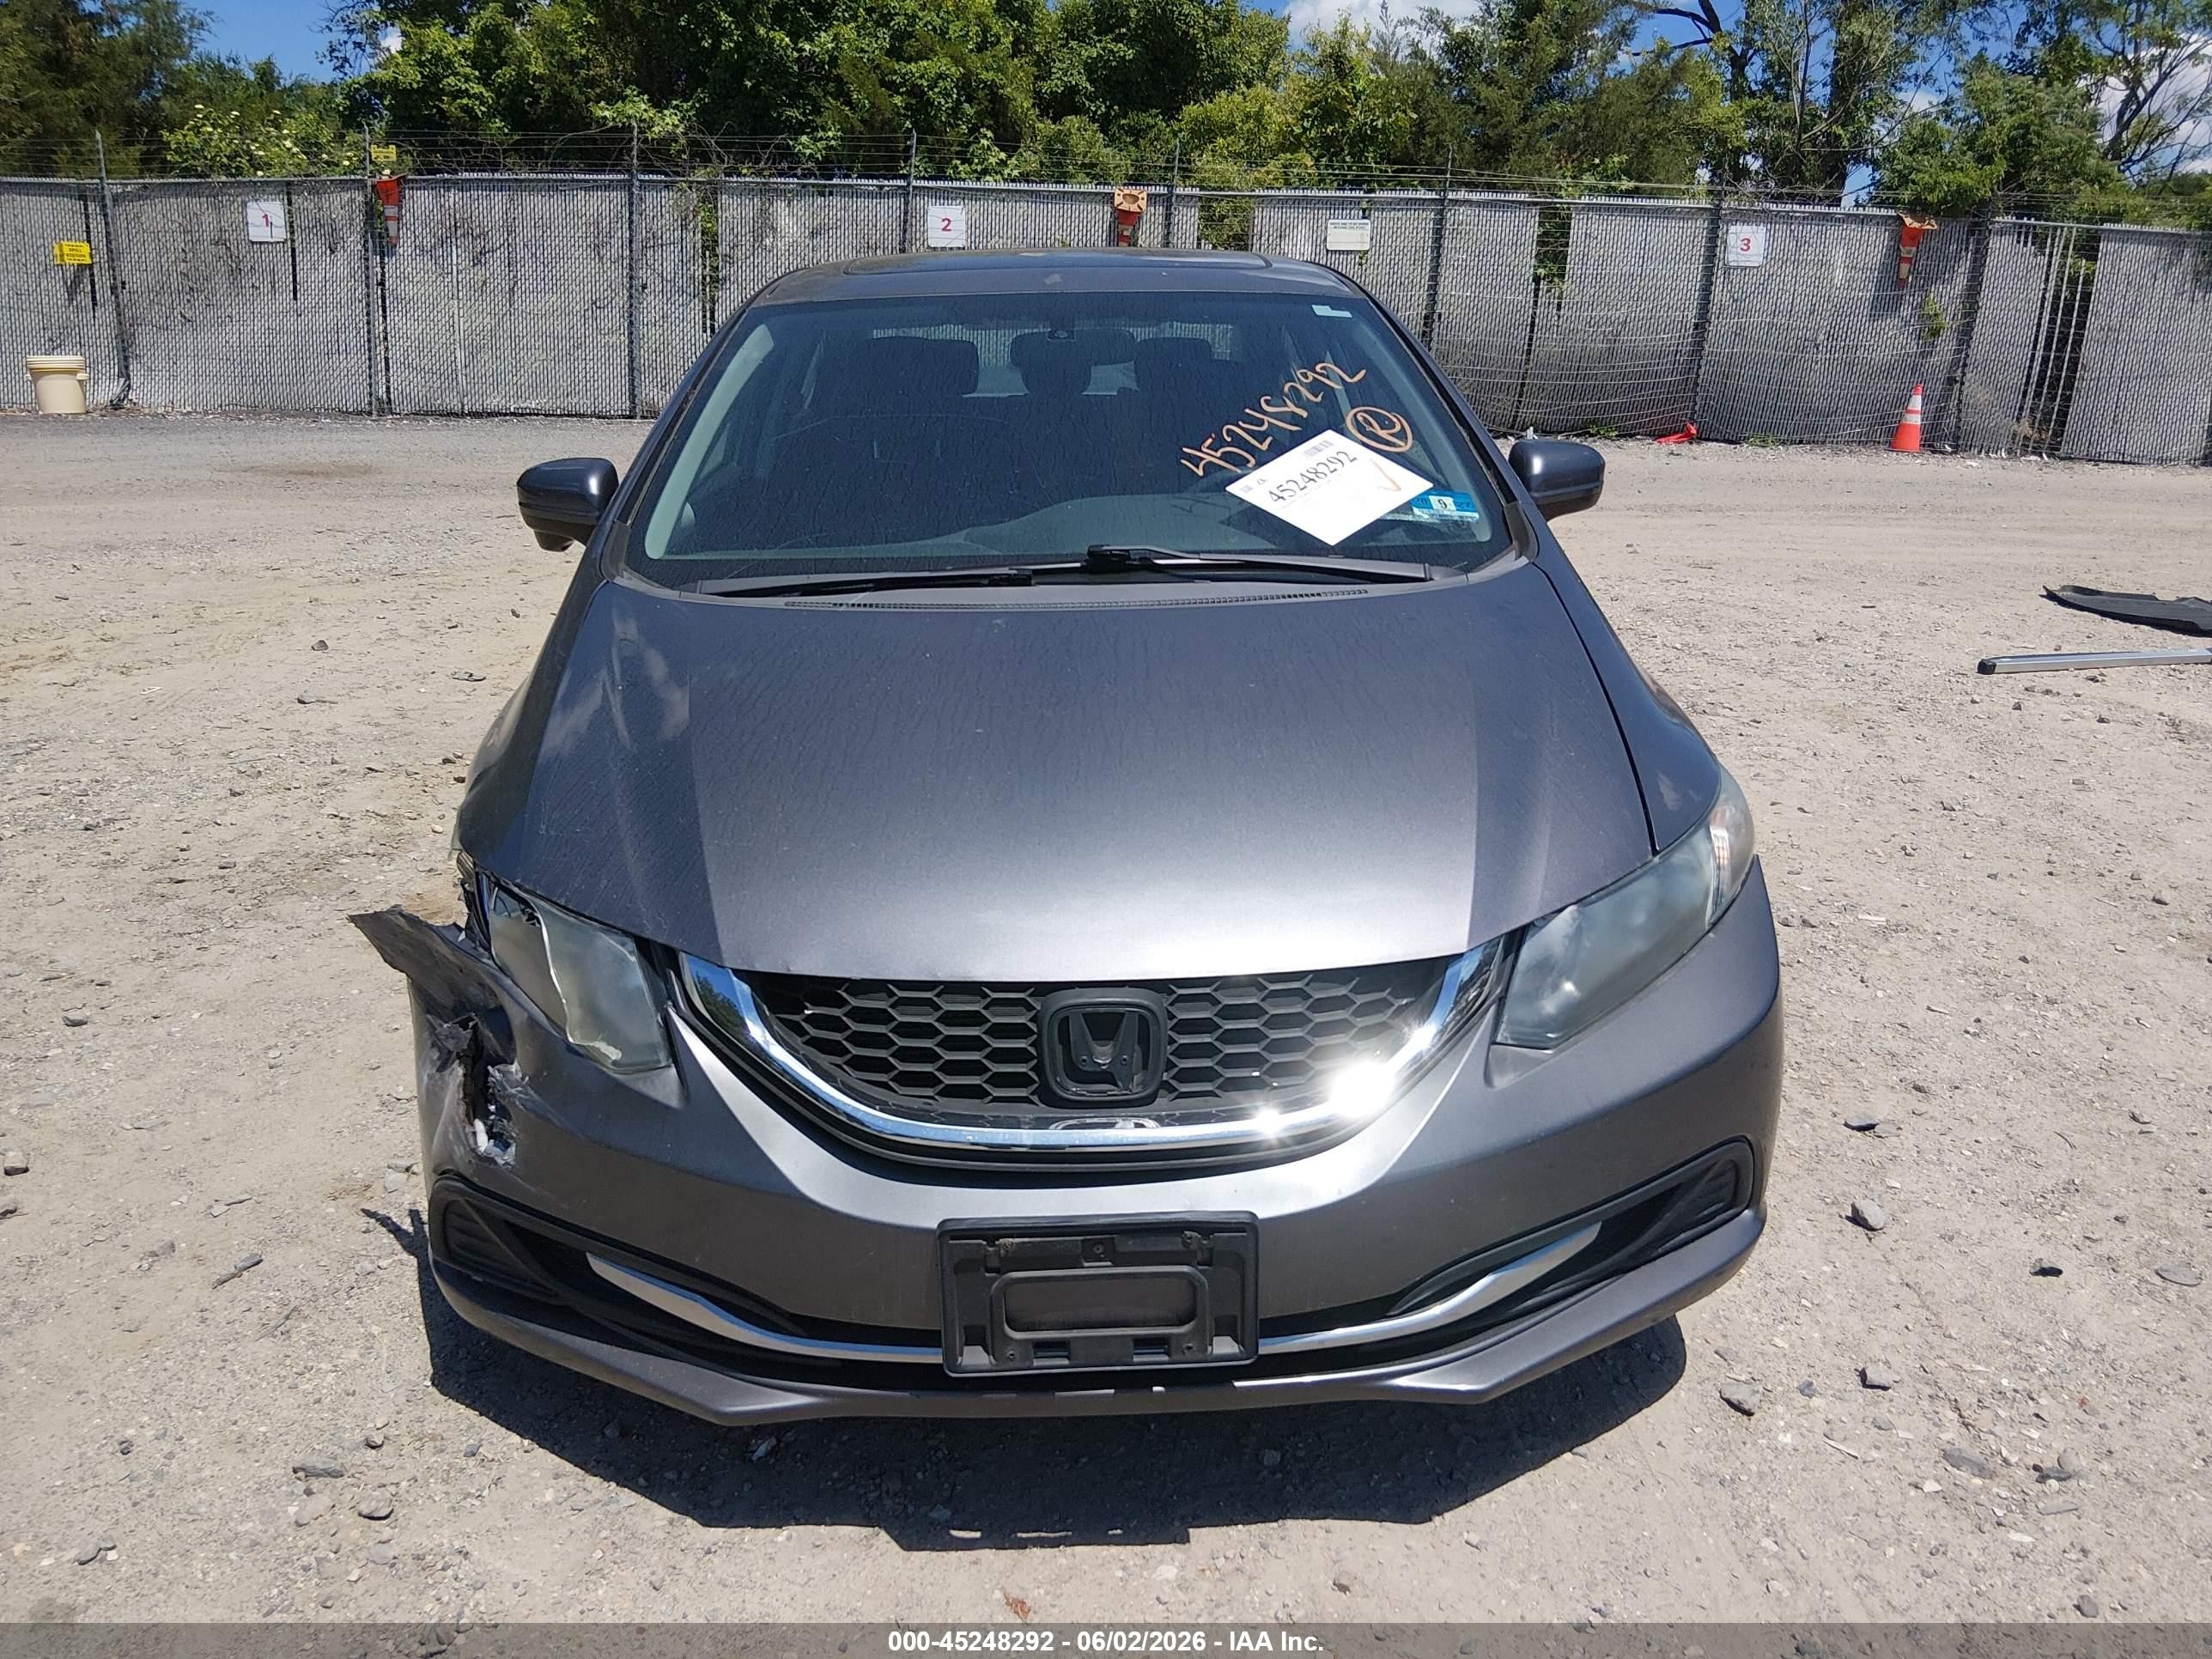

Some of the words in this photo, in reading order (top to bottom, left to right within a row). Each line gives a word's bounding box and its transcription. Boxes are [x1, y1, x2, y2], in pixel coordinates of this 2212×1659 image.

[262, 213, 270, 228] 1
[941, 217, 952, 232] 2
[1740, 237, 1752, 252] 3
[1181, 362, 1366, 477] 45248292
[1268, 451, 1358, 502] 45248292
[1437, 498, 1448, 509] 9
